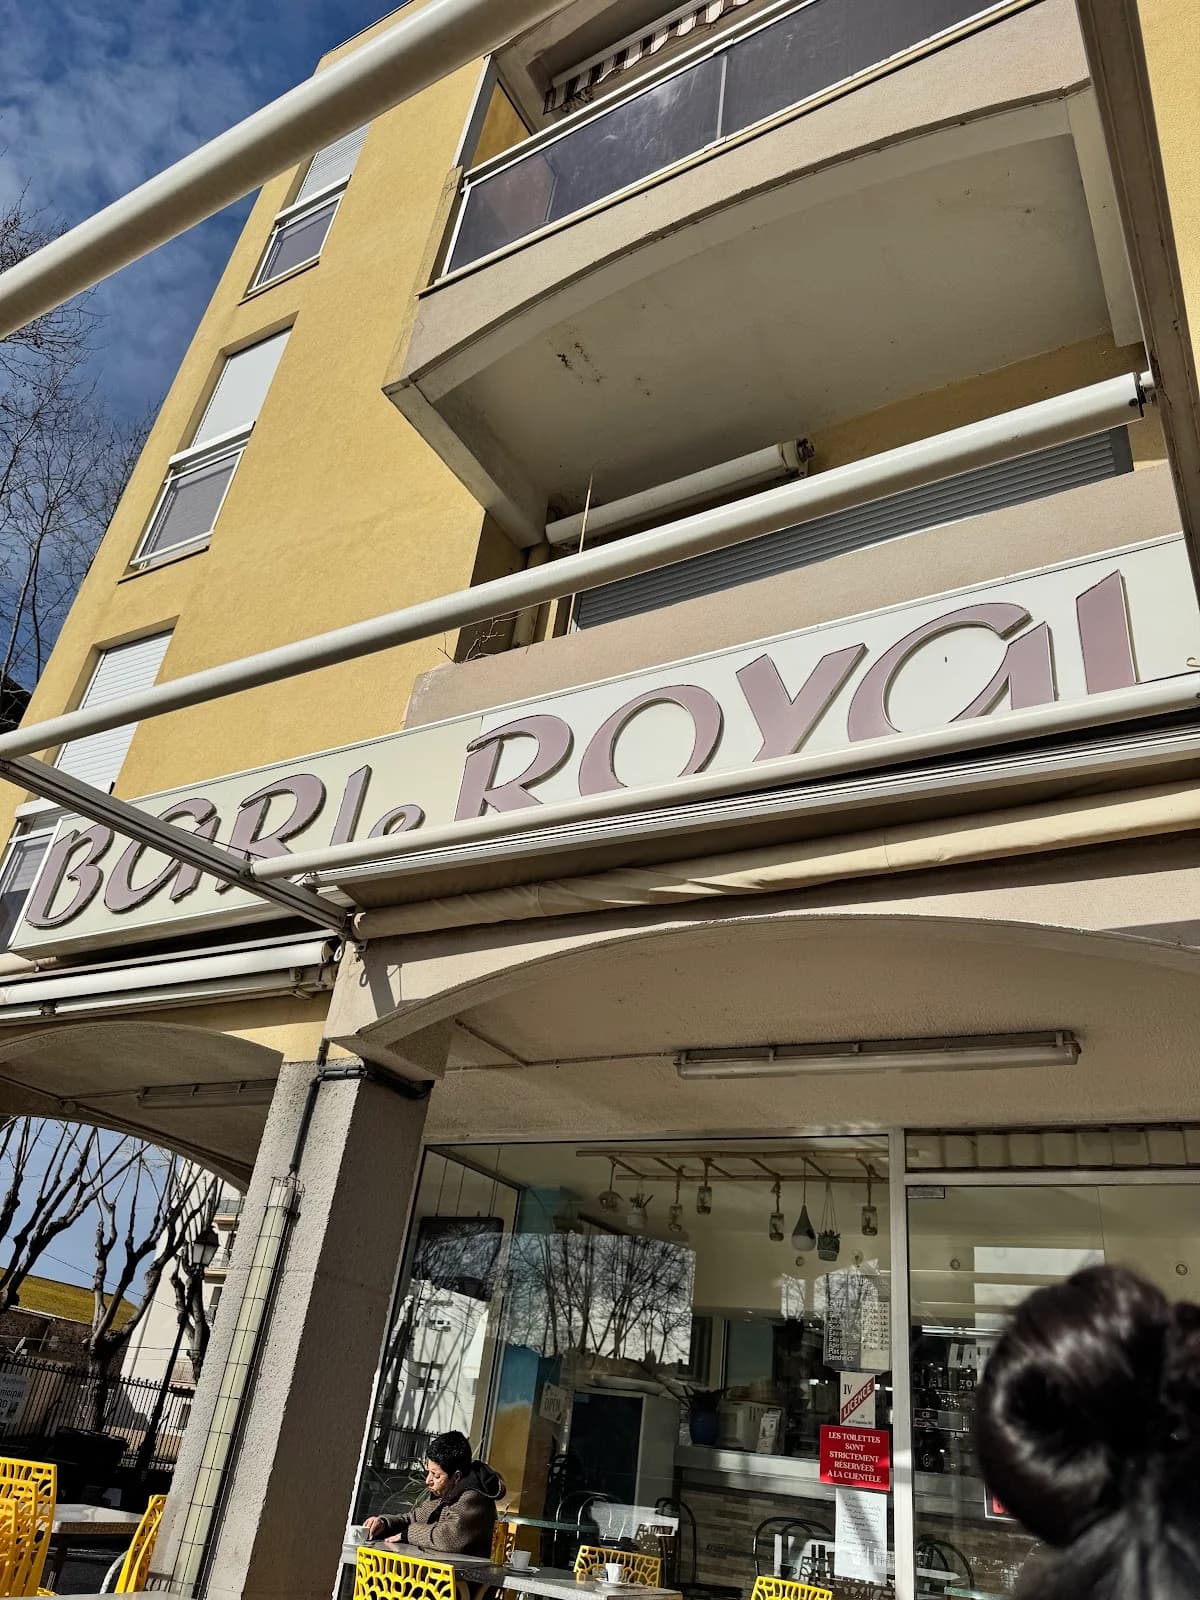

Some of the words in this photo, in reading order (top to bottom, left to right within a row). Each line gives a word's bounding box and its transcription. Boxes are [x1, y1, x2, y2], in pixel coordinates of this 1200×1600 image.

[843, 1384, 853, 1395] IV
[842, 1382, 873, 1418] LICENCE
[829, 1431, 841, 1440] LES
[842, 1432, 881, 1444] TOILETTES
[845, 1443, 865, 1452] SONT
[829, 1451, 880, 1463] STRICTEMENT
[833, 1470, 843, 1478] LA
